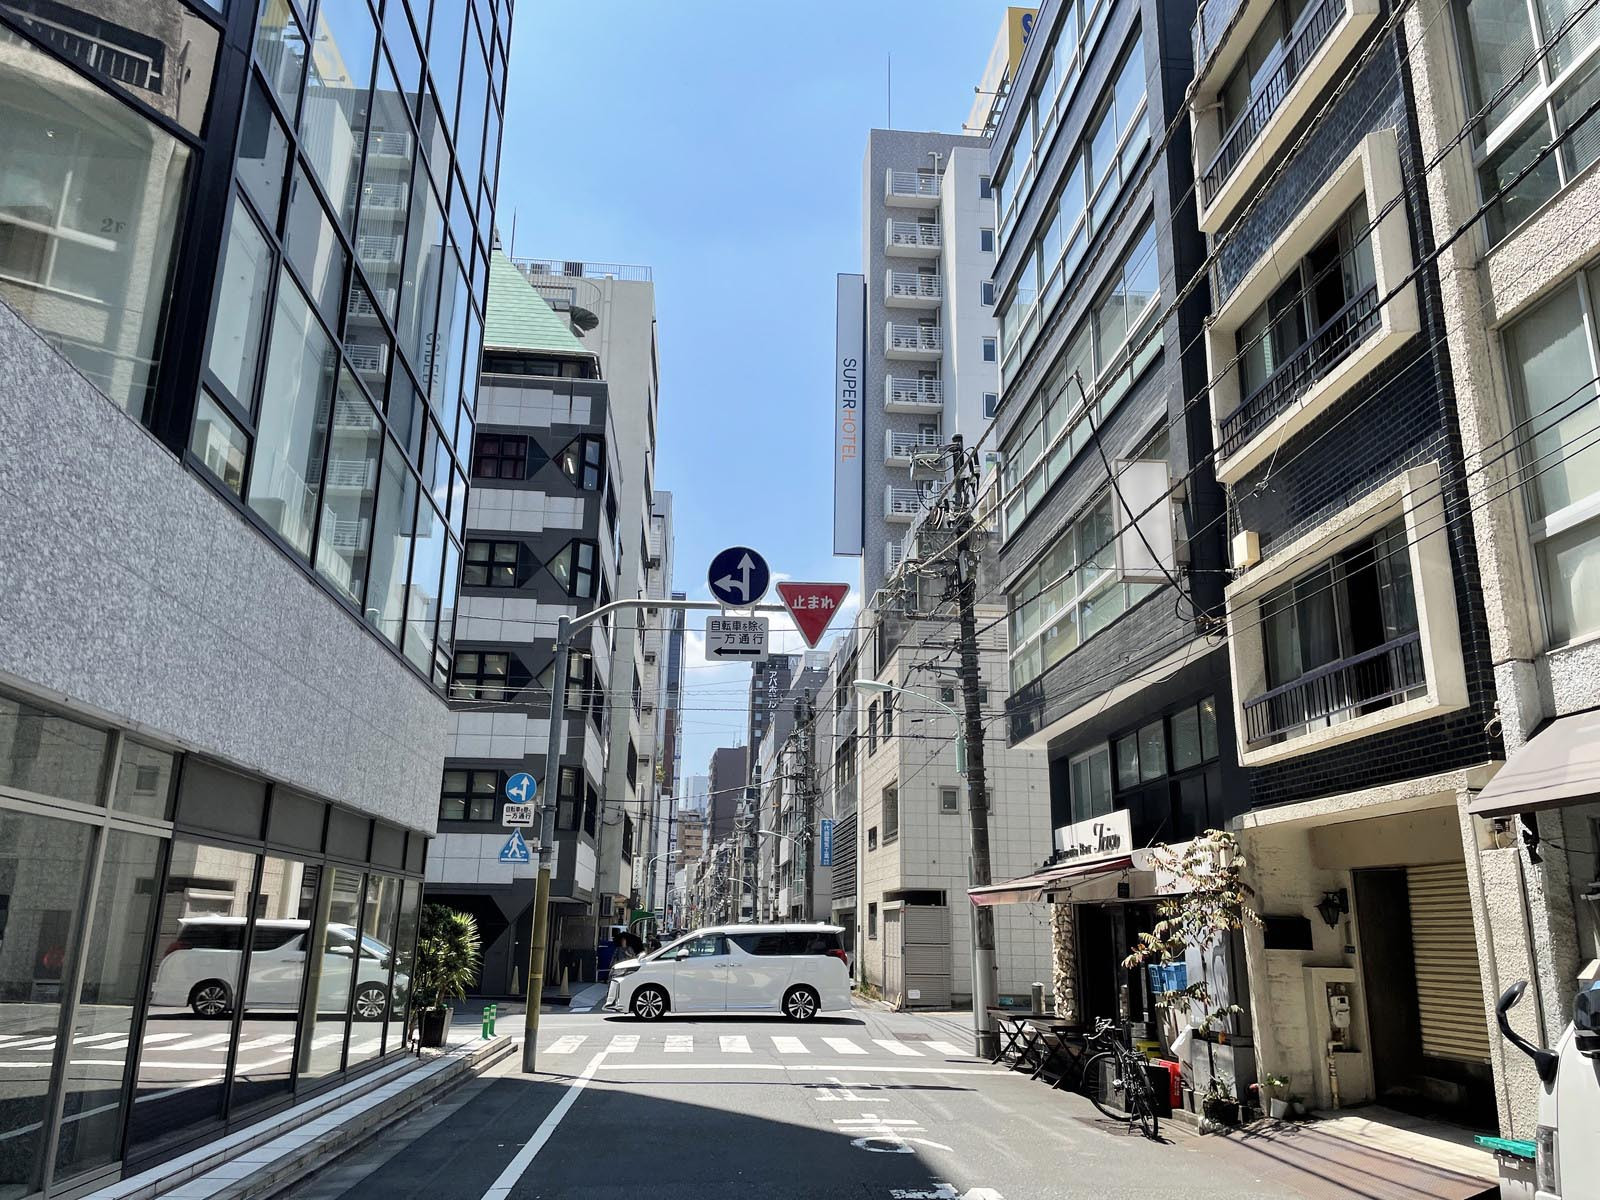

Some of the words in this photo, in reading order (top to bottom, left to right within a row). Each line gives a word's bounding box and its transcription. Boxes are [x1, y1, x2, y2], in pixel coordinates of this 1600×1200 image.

[792, 595, 835, 610] 止まれ
[711, 620, 764, 632] 自転車を除く
[711, 633, 764, 645] 一方通行
